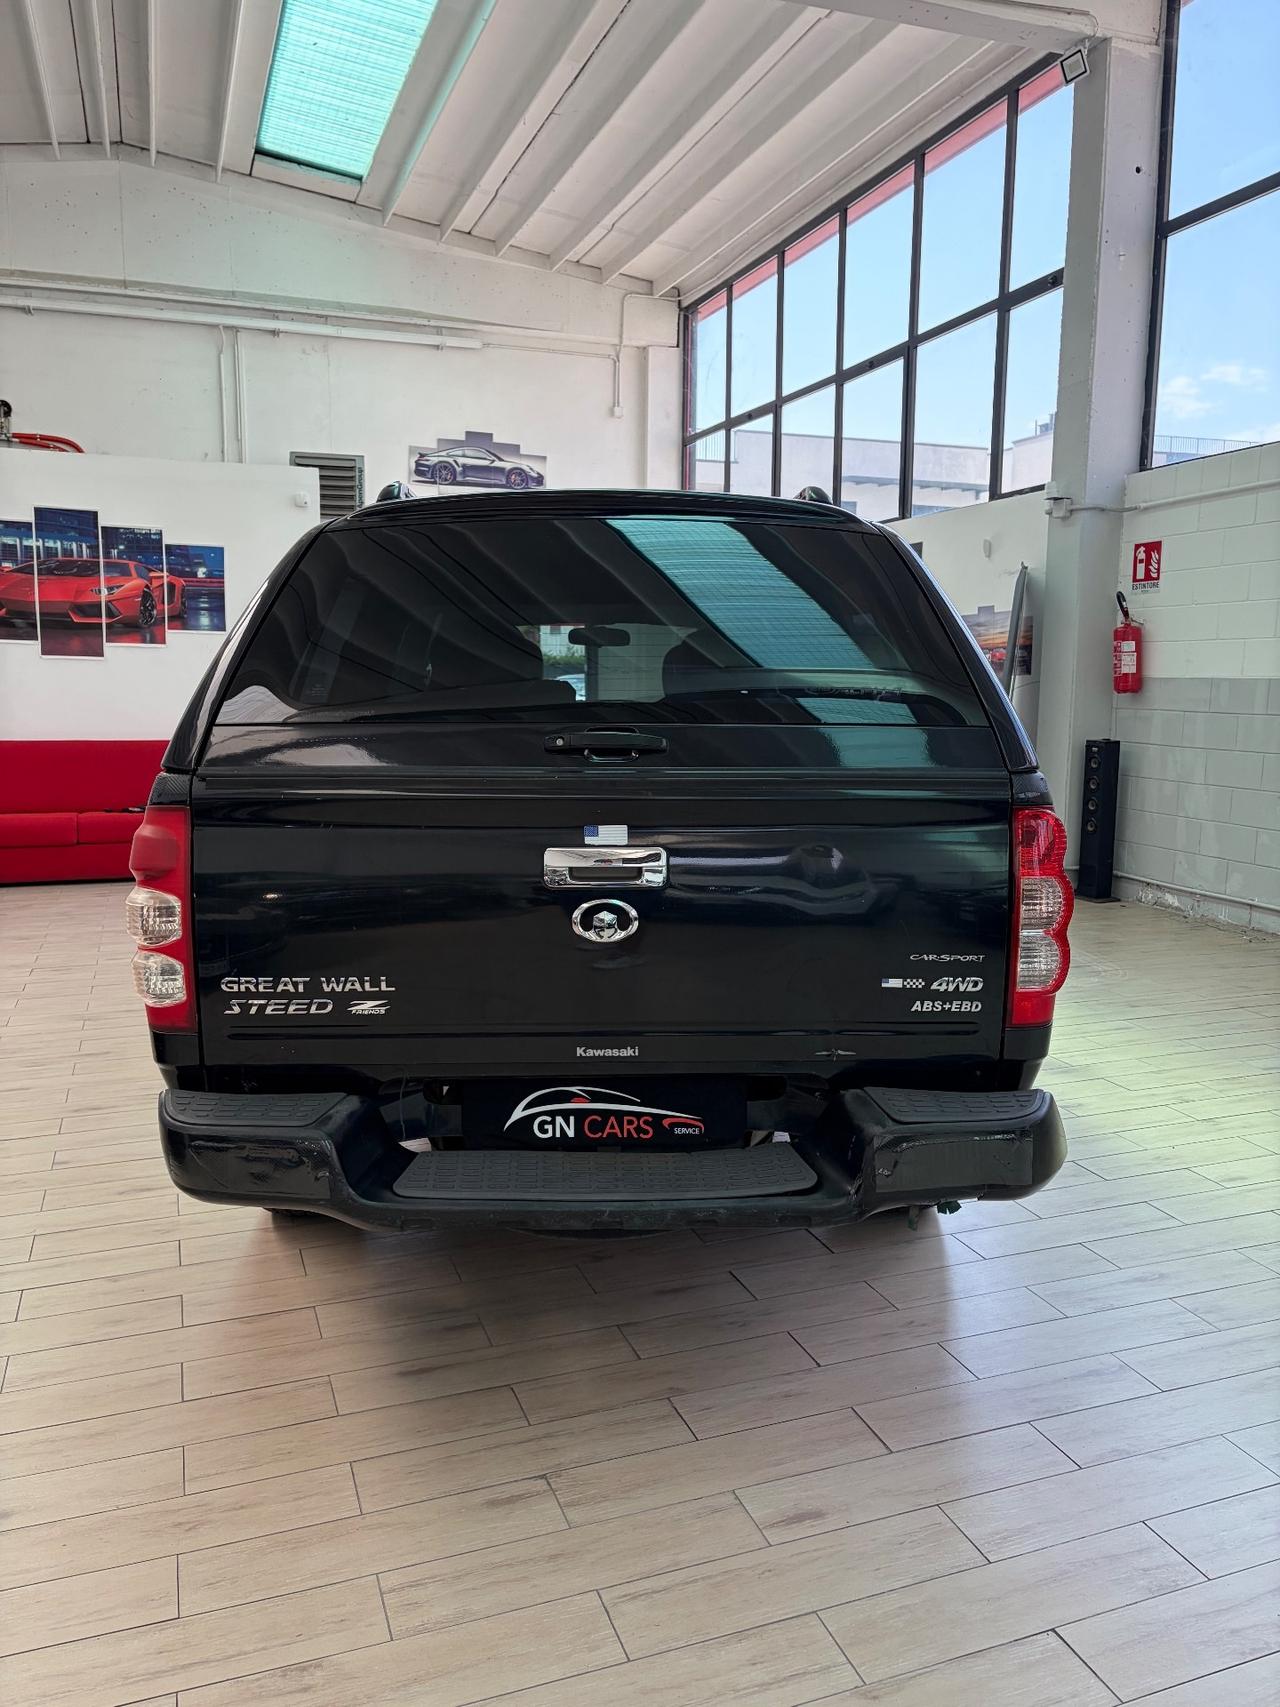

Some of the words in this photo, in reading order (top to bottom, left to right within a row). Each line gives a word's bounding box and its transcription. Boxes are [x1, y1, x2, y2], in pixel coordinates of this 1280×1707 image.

[1132, 582, 1159, 590] ESTINTORE
[220, 976, 310, 992] GREAT
[320, 976, 396, 992] WALL
[930, 977, 984, 992] 4WD
[223, 999, 334, 1015] STEED
[911, 1000, 982, 1012] ABS+EBD
[576, 1046, 639, 1057] Kawasaki
[533, 1115, 575, 1139] GN
[583, 1115, 653, 1139] CARS
[673, 1127, 700, 1135] SERVICE
